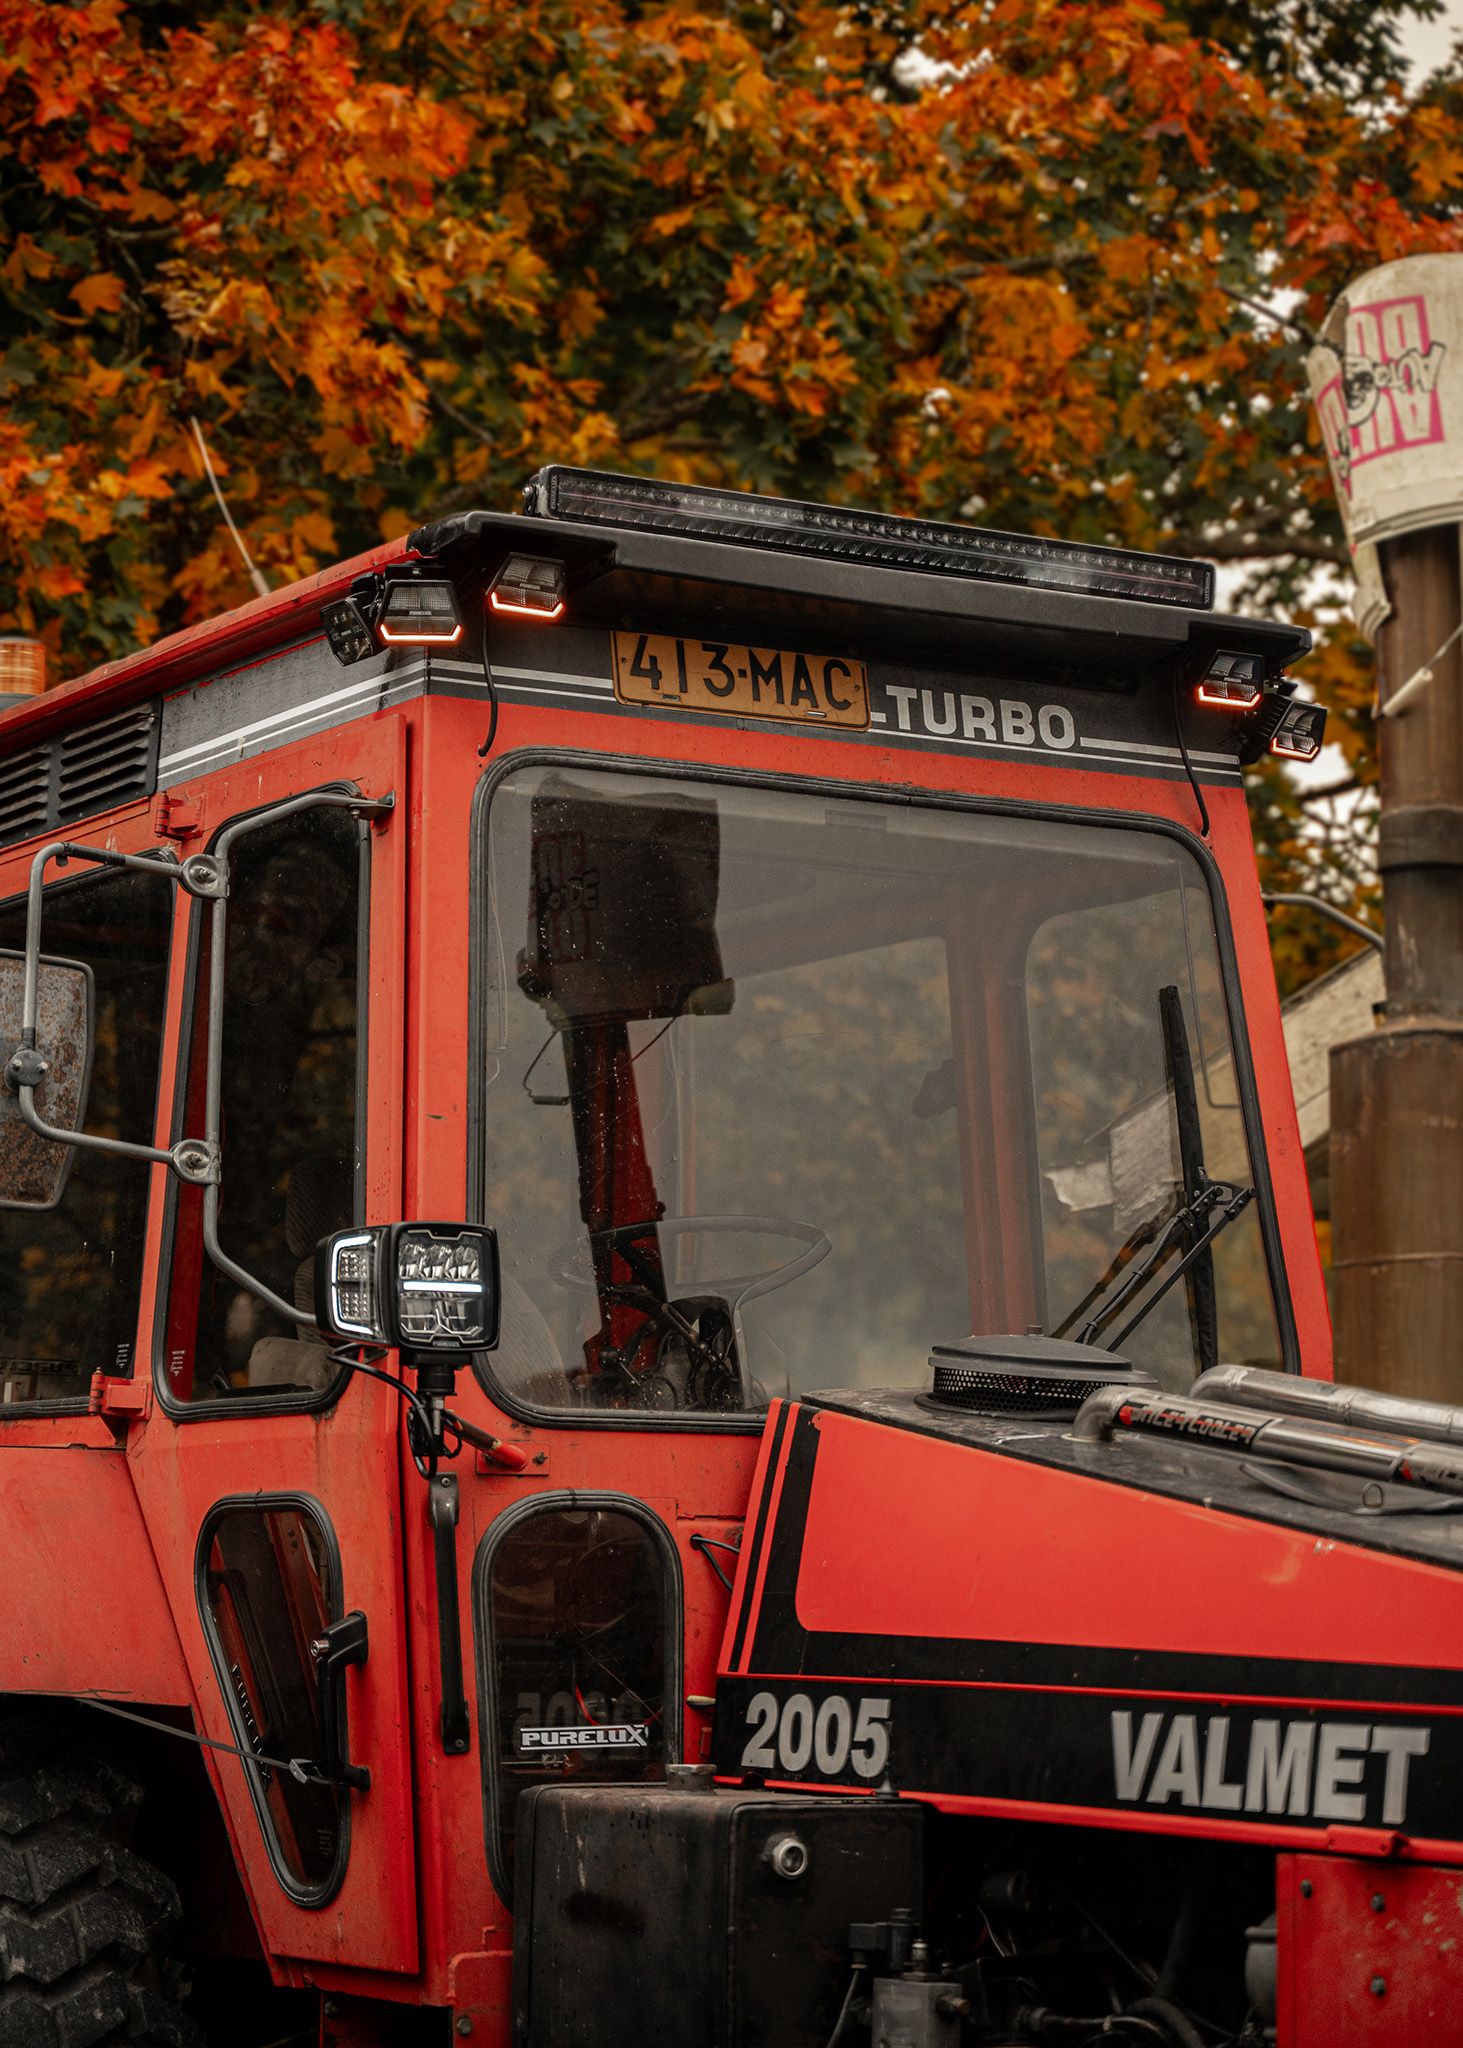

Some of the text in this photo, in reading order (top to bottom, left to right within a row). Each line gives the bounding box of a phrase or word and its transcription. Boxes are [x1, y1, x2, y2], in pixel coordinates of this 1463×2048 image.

[886, 684, 1075, 750] TURBO
[521, 1724, 647, 1748] PURELUX
[741, 1691, 891, 1778] 2005
[1111, 1710, 1431, 1824] VALMET
